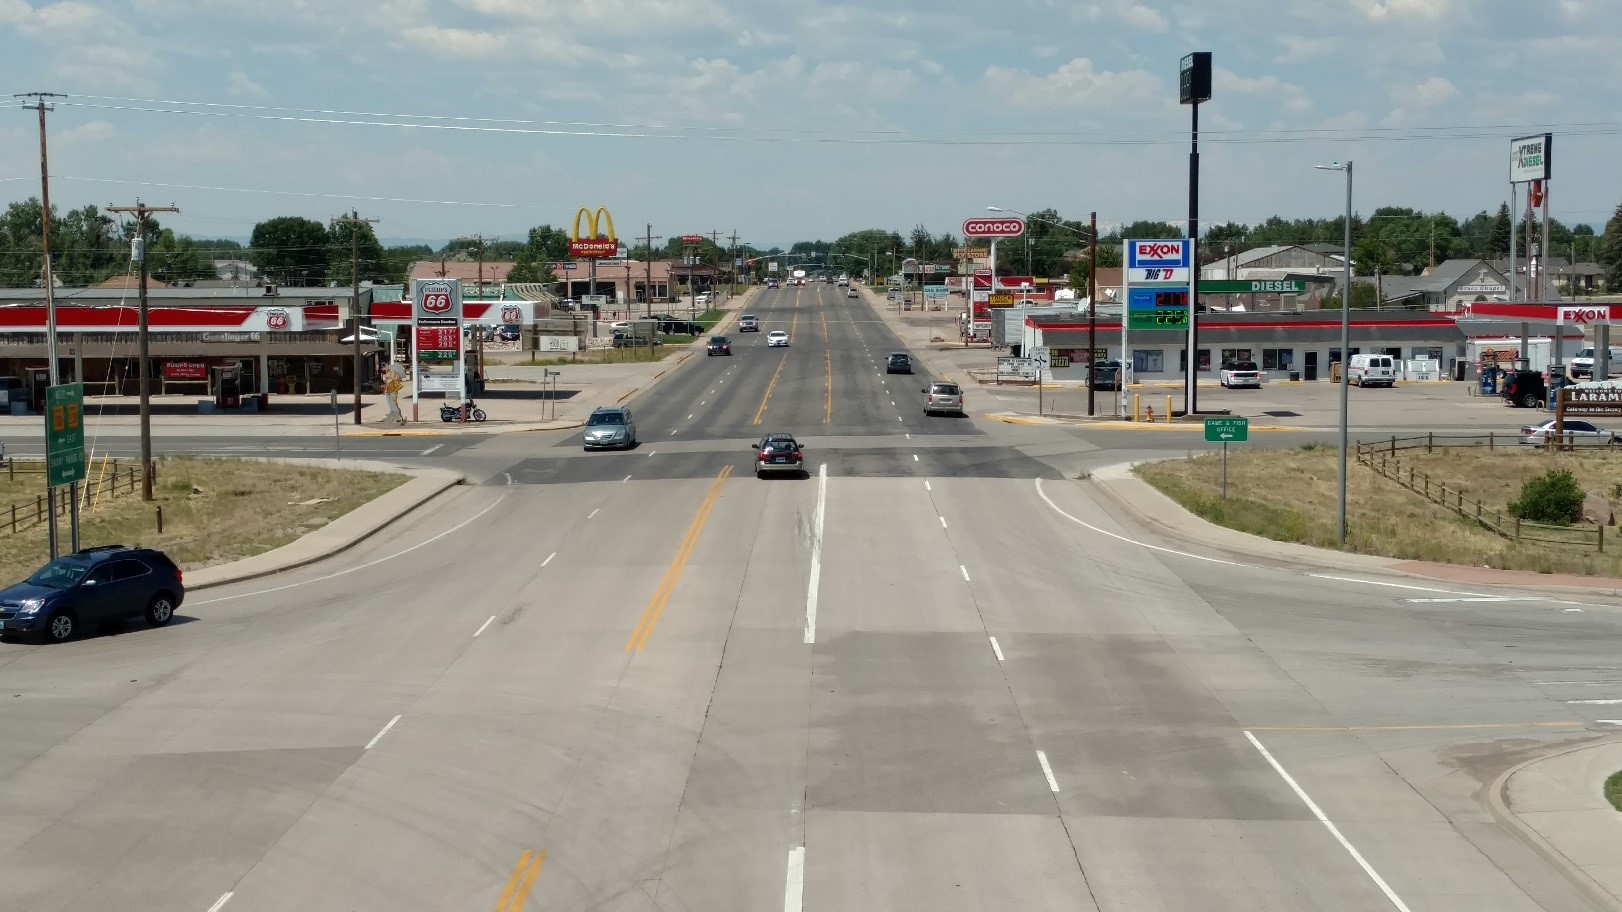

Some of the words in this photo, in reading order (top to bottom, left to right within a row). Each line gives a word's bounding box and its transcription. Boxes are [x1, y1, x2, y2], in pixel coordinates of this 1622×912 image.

[1138, 243, 1180, 259] EXXON
[1145, 269, 1160, 280] BIG
[1162, 269, 1174, 280] D
[1251, 280, 1299, 291] DIESEL
[426, 295, 447, 308] 66
[270, 316, 284, 325] 66
[504, 311, 517, 320] 66
[1563, 308, 1606, 324] EXXON
[202, 332, 249, 341] Gunslinger
[250, 332, 260, 340] 66
[1051, 359, 1070, 367] PIZZA
[1571, 391, 1622, 401] LARAM
